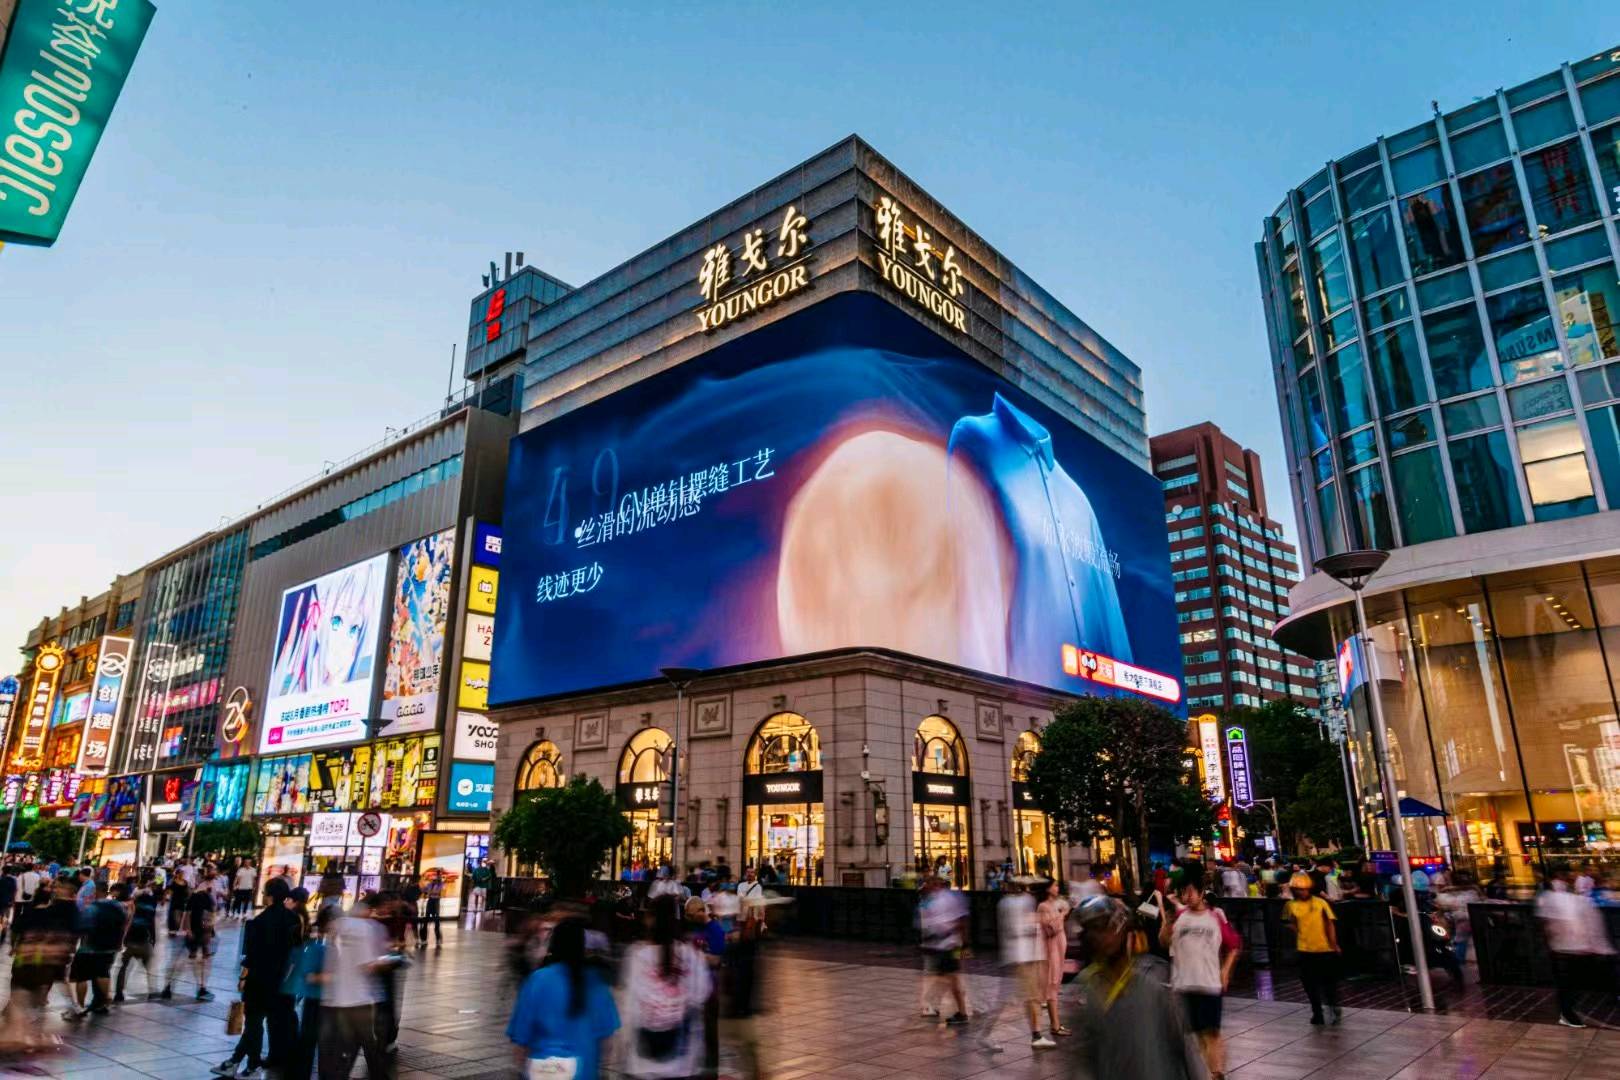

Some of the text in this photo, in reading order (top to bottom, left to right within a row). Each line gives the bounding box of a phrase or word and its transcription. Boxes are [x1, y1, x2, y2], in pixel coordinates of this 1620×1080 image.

[0, 49, 93, 216] mosaic
[698, 205, 809, 301] 雅戈尔
[876, 196, 964, 297] 雅戈尔
[696, 264, 809, 332] YOUNGOR
[877, 252, 967, 334] YOUNGOR
[535, 561, 605, 604] 线迹更少
[474, 739, 497, 749] SHO
[765, 782, 801, 793] YOUNGOR
